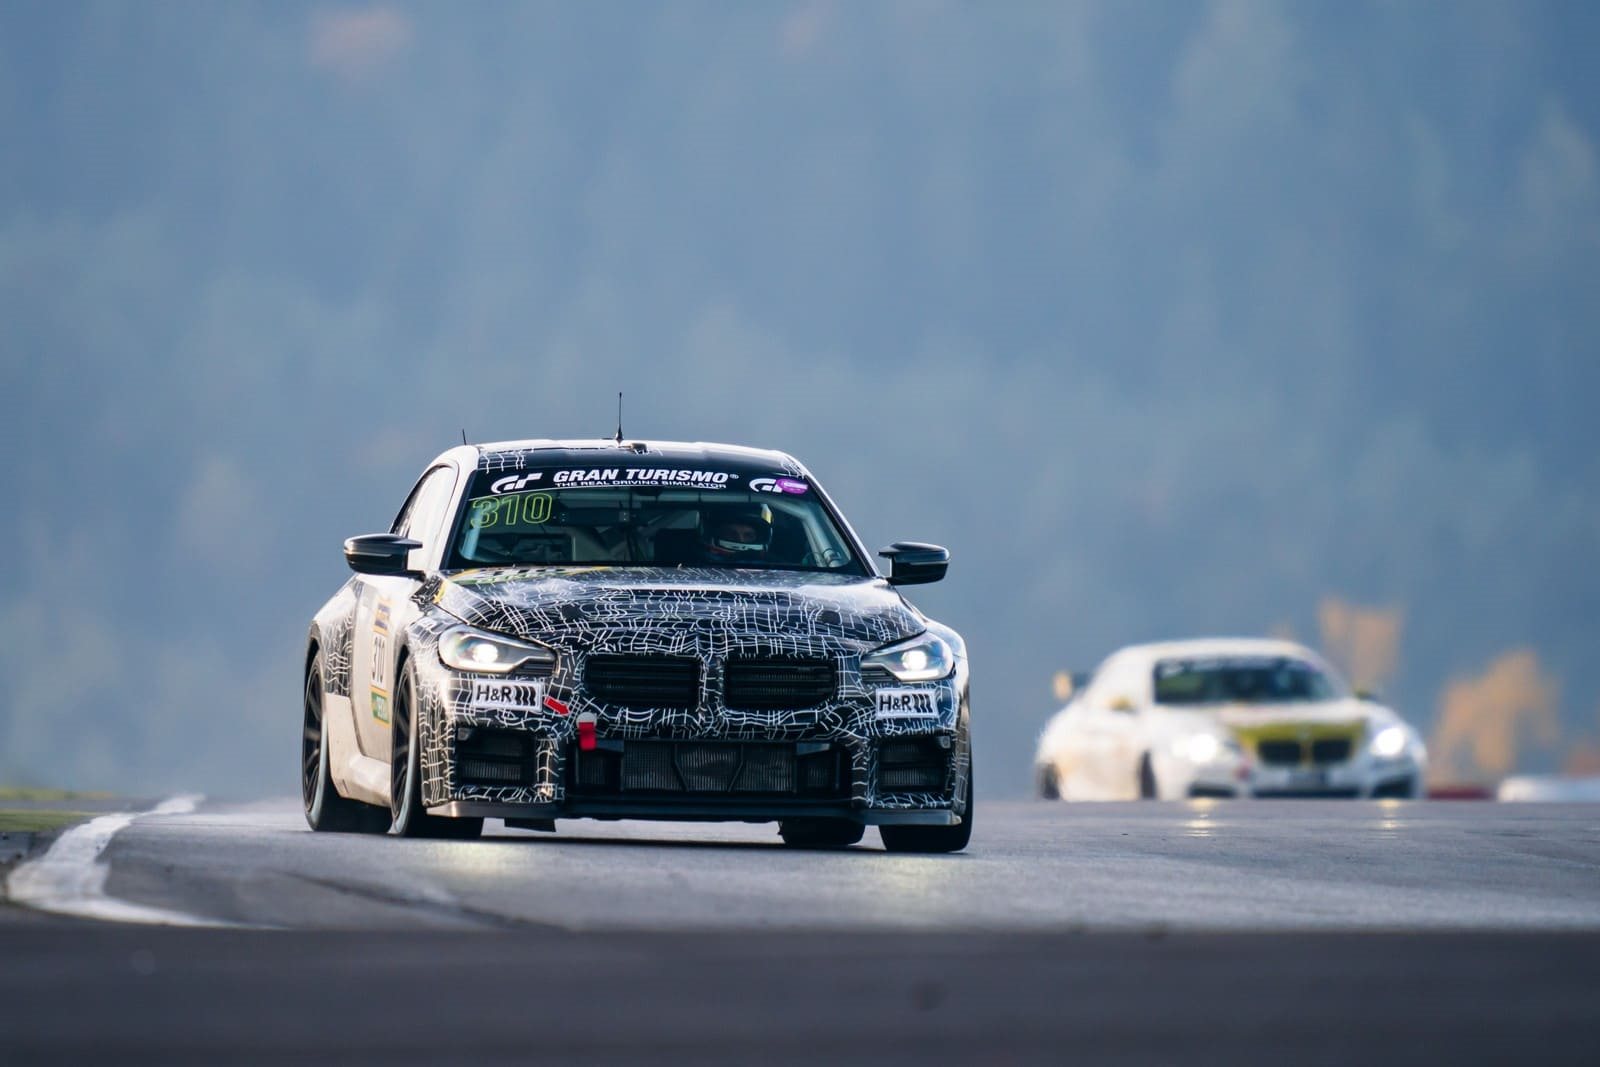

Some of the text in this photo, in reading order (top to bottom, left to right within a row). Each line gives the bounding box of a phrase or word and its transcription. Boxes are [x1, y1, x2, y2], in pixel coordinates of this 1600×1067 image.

[553, 469, 619, 482] GRAN
[662, 480, 727, 489] SIMULATOR
[470, 493, 552, 528] 310
[371, 636, 385, 683] 310
[476, 684, 512, 702] H&R
[879, 694, 912, 712] H&R
